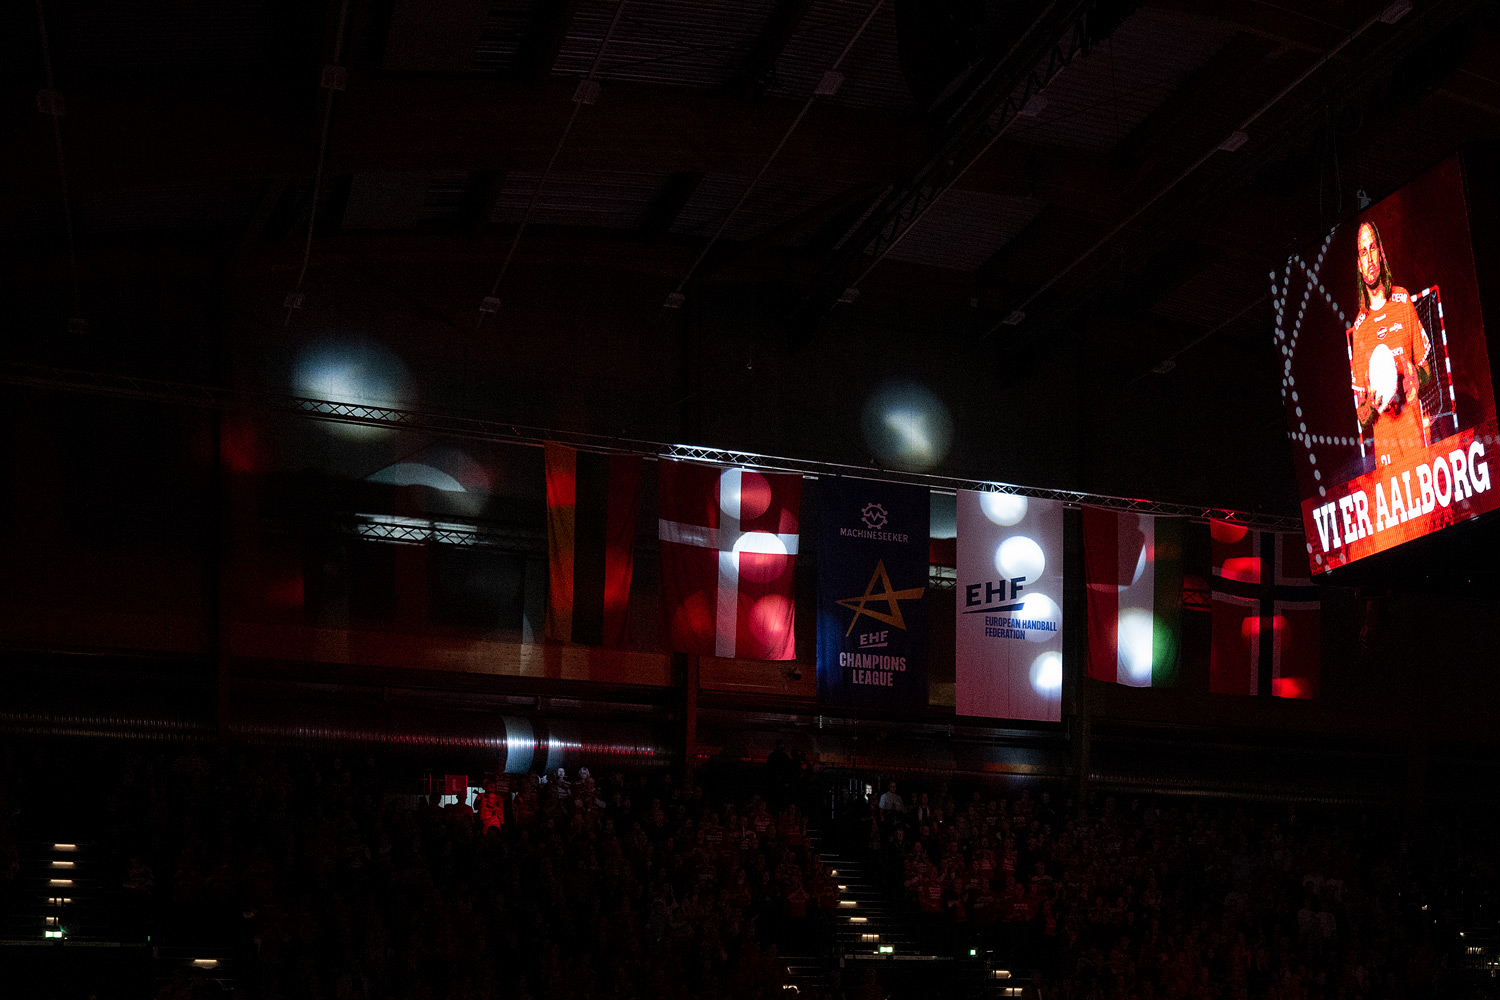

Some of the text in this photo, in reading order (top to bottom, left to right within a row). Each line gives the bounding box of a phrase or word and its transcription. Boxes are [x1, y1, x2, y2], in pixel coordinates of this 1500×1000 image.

[1312, 441, 1491, 553] VI ER AALBORG
[839, 527, 909, 543] MACHINESEEKER
[965, 576, 1027, 607] EHF
[985, 616, 1058, 632] EUROPEAN HANDBALL
[859, 630, 889, 646] EHF
[985, 628, 1026, 640] FEDERATION
[839, 652, 907, 673] CHAMPIONS
[852, 670, 894, 687] LEAGUE
